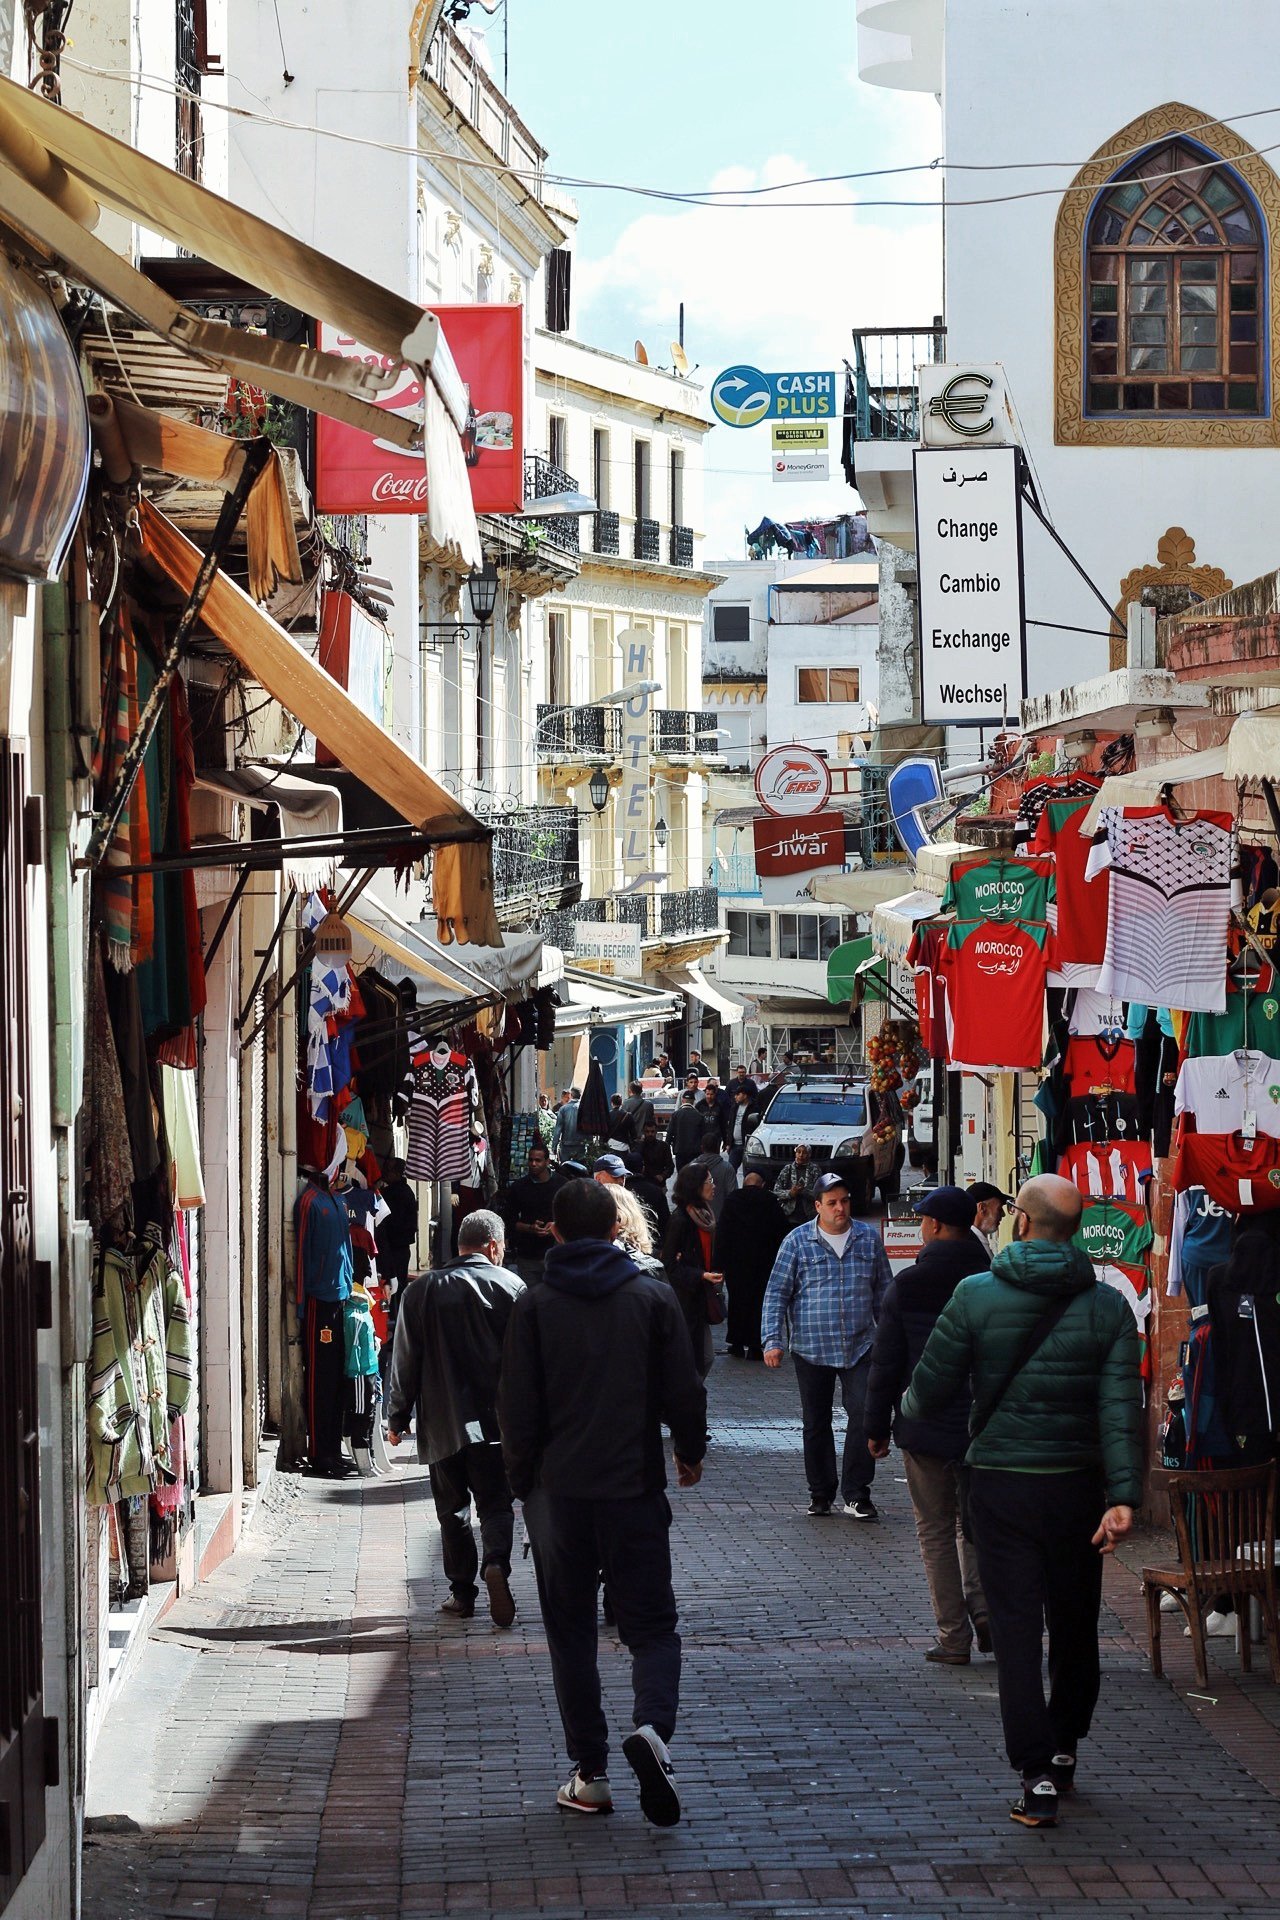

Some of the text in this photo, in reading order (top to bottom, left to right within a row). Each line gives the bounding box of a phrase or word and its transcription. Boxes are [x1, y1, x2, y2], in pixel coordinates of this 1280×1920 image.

[776, 375, 830, 394] CASH
[777, 396, 830, 415] PLUS
[787, 463, 825, 471] MoneyGram
[942, 467, 988, 487] صرف
[937, 518, 998, 542] Change
[939, 573, 1001, 594] Cambio
[932, 628, 1010, 652] Exchange
[940, 683, 1007, 704] Wechsel
[626, 643, 649, 861] HOTEL
[784, 779, 822, 794] FRS
[771, 841, 829, 857] Jiwar
[975, 881, 1025, 900] MOROCCO
[575, 943, 600, 957] PENSION
[975, 941, 1024, 958] MOROCCO
[1097, 1014, 1125, 1026] PAYET
[1082, 1224, 1125, 1241] MOROCCO
